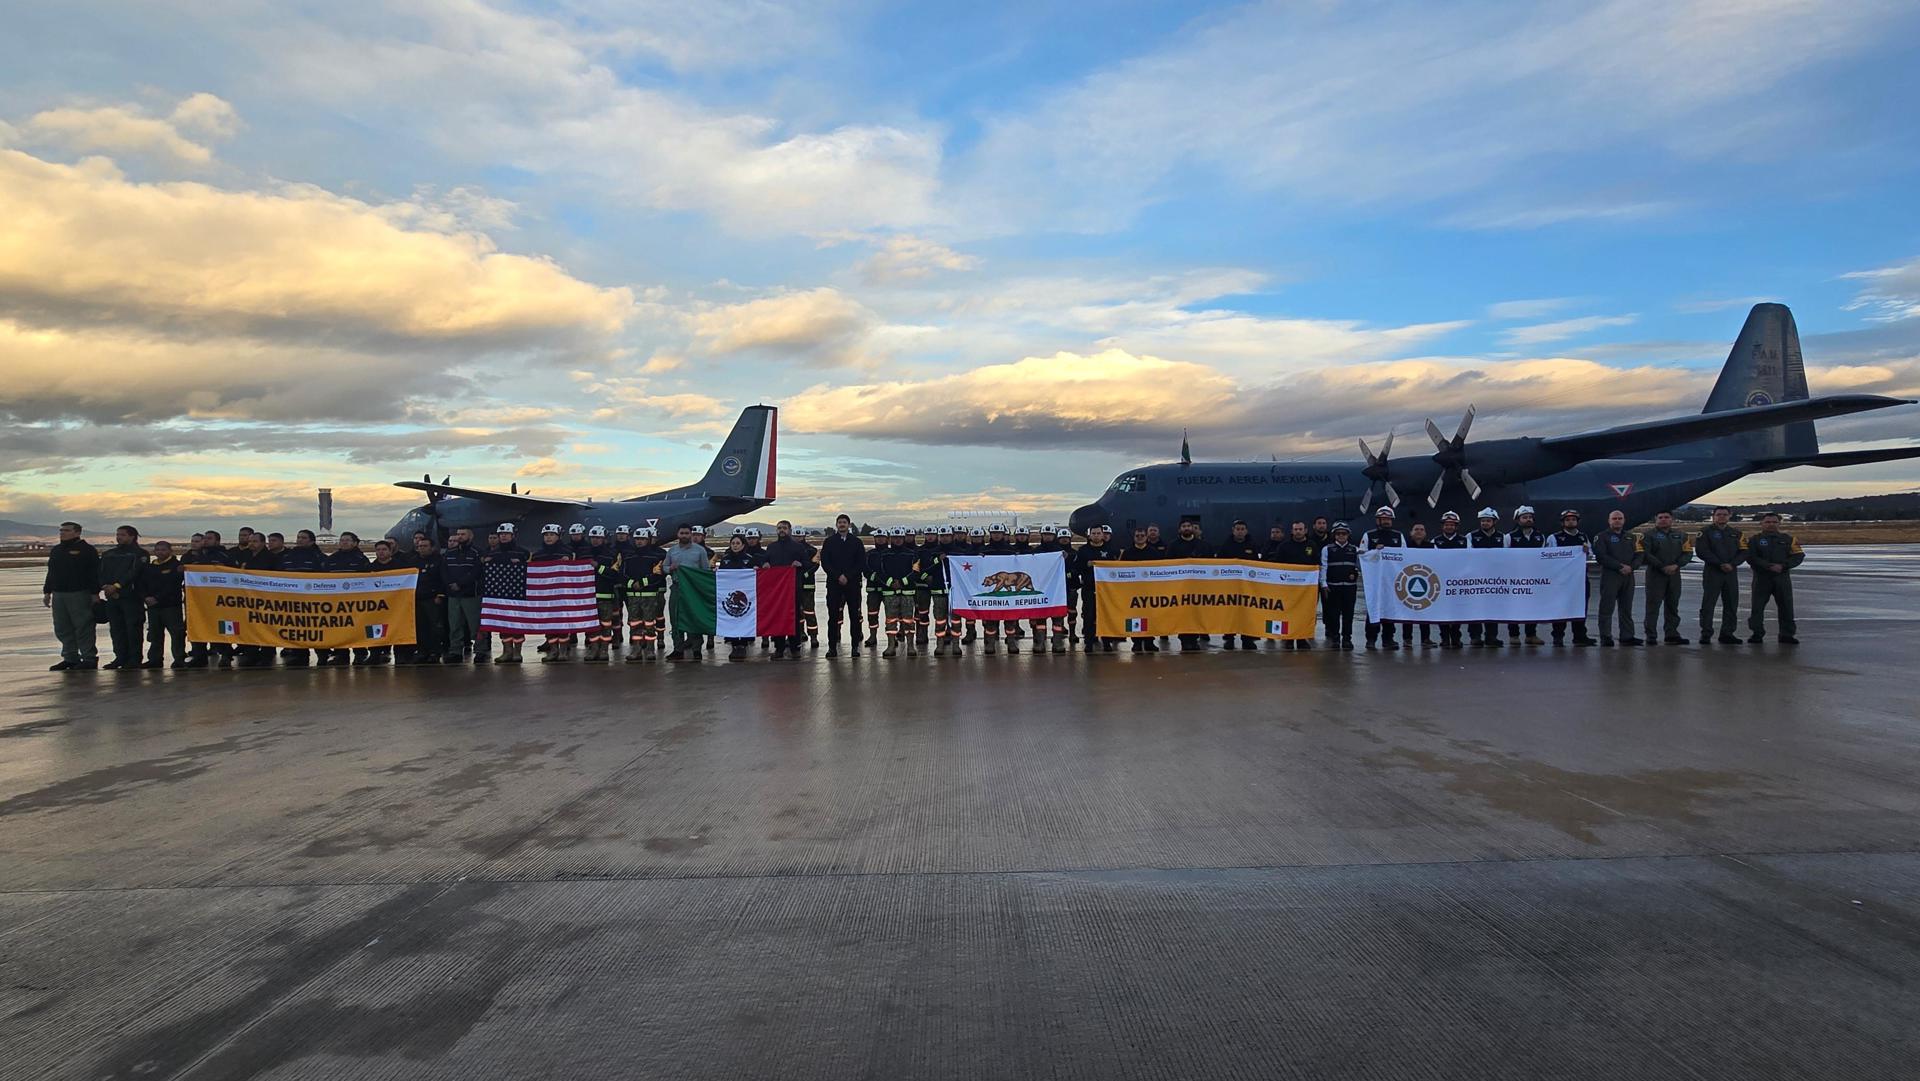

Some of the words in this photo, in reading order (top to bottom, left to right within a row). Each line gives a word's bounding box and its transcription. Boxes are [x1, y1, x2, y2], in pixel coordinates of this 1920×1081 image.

[1177, 476, 1223, 485] FUERZA
[1228, 475, 1267, 485] AEREA
[1272, 475, 1332, 484] MEXICANA
[240, 577, 268, 586] Relaciones
[269, 580, 298, 588] Exteriores
[1446, 577, 1507, 586] COORDINACIÓN
[1459, 586, 1510, 595] PROTECCIÓN
[216, 595, 334, 613] AGRUPAMIENTO
[336, 599, 389, 612] AYUDA
[968, 599, 1010, 607] CALIFORNIA
[1015, 597, 1049, 606] REPUBLIC
[1130, 595, 1179, 608] AYUDA
[1181, 593, 1284, 611] HUMANITARIA
[248, 611, 355, 628] HUMANITARIA
[278, 629, 324, 642] CEHUI
